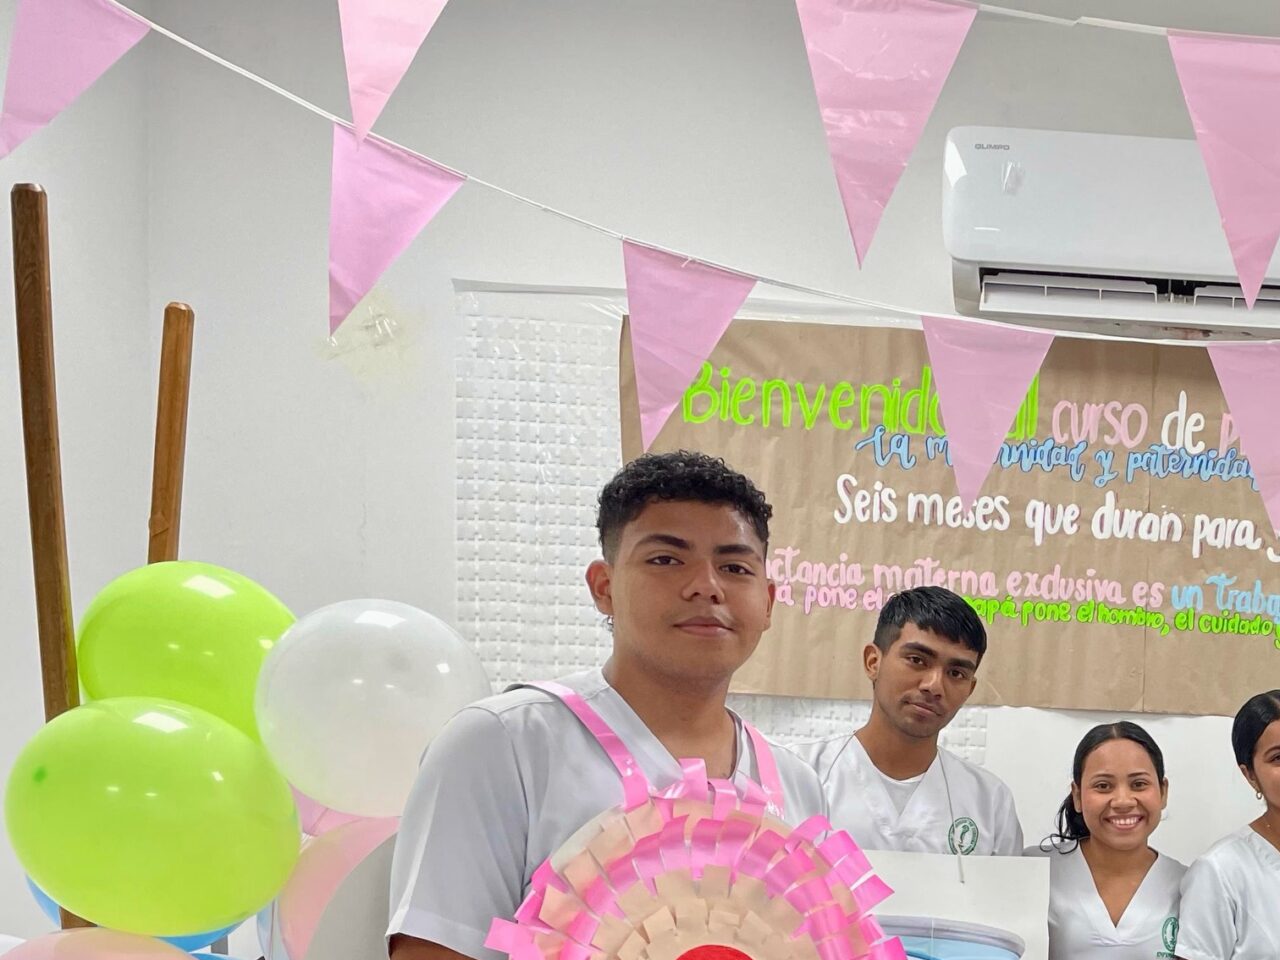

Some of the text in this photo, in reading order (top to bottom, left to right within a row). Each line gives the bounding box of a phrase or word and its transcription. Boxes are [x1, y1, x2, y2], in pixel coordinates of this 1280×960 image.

[1052, 400, 1148, 449] curso
[1161, 390, 1205, 454] de
[1094, 449, 1119, 488] y
[834, 474, 897, 524] Seis
[1025, 499, 1081, 546] que
[1091, 490, 1183, 542] duran
[1193, 513, 1262, 558] para
[803, 585, 858, 615] pone
[1020, 601, 1071, 627] pone
[1076, 599, 1096, 623] el
[1174, 608, 1195, 631] el
[1199, 610, 1273, 636] cuidado
[873, 557, 998, 596] materna
[1007, 563, 1126, 604] exclusiva
[1132, 581, 1165, 608] es
[1171, 584, 1203, 612] un
